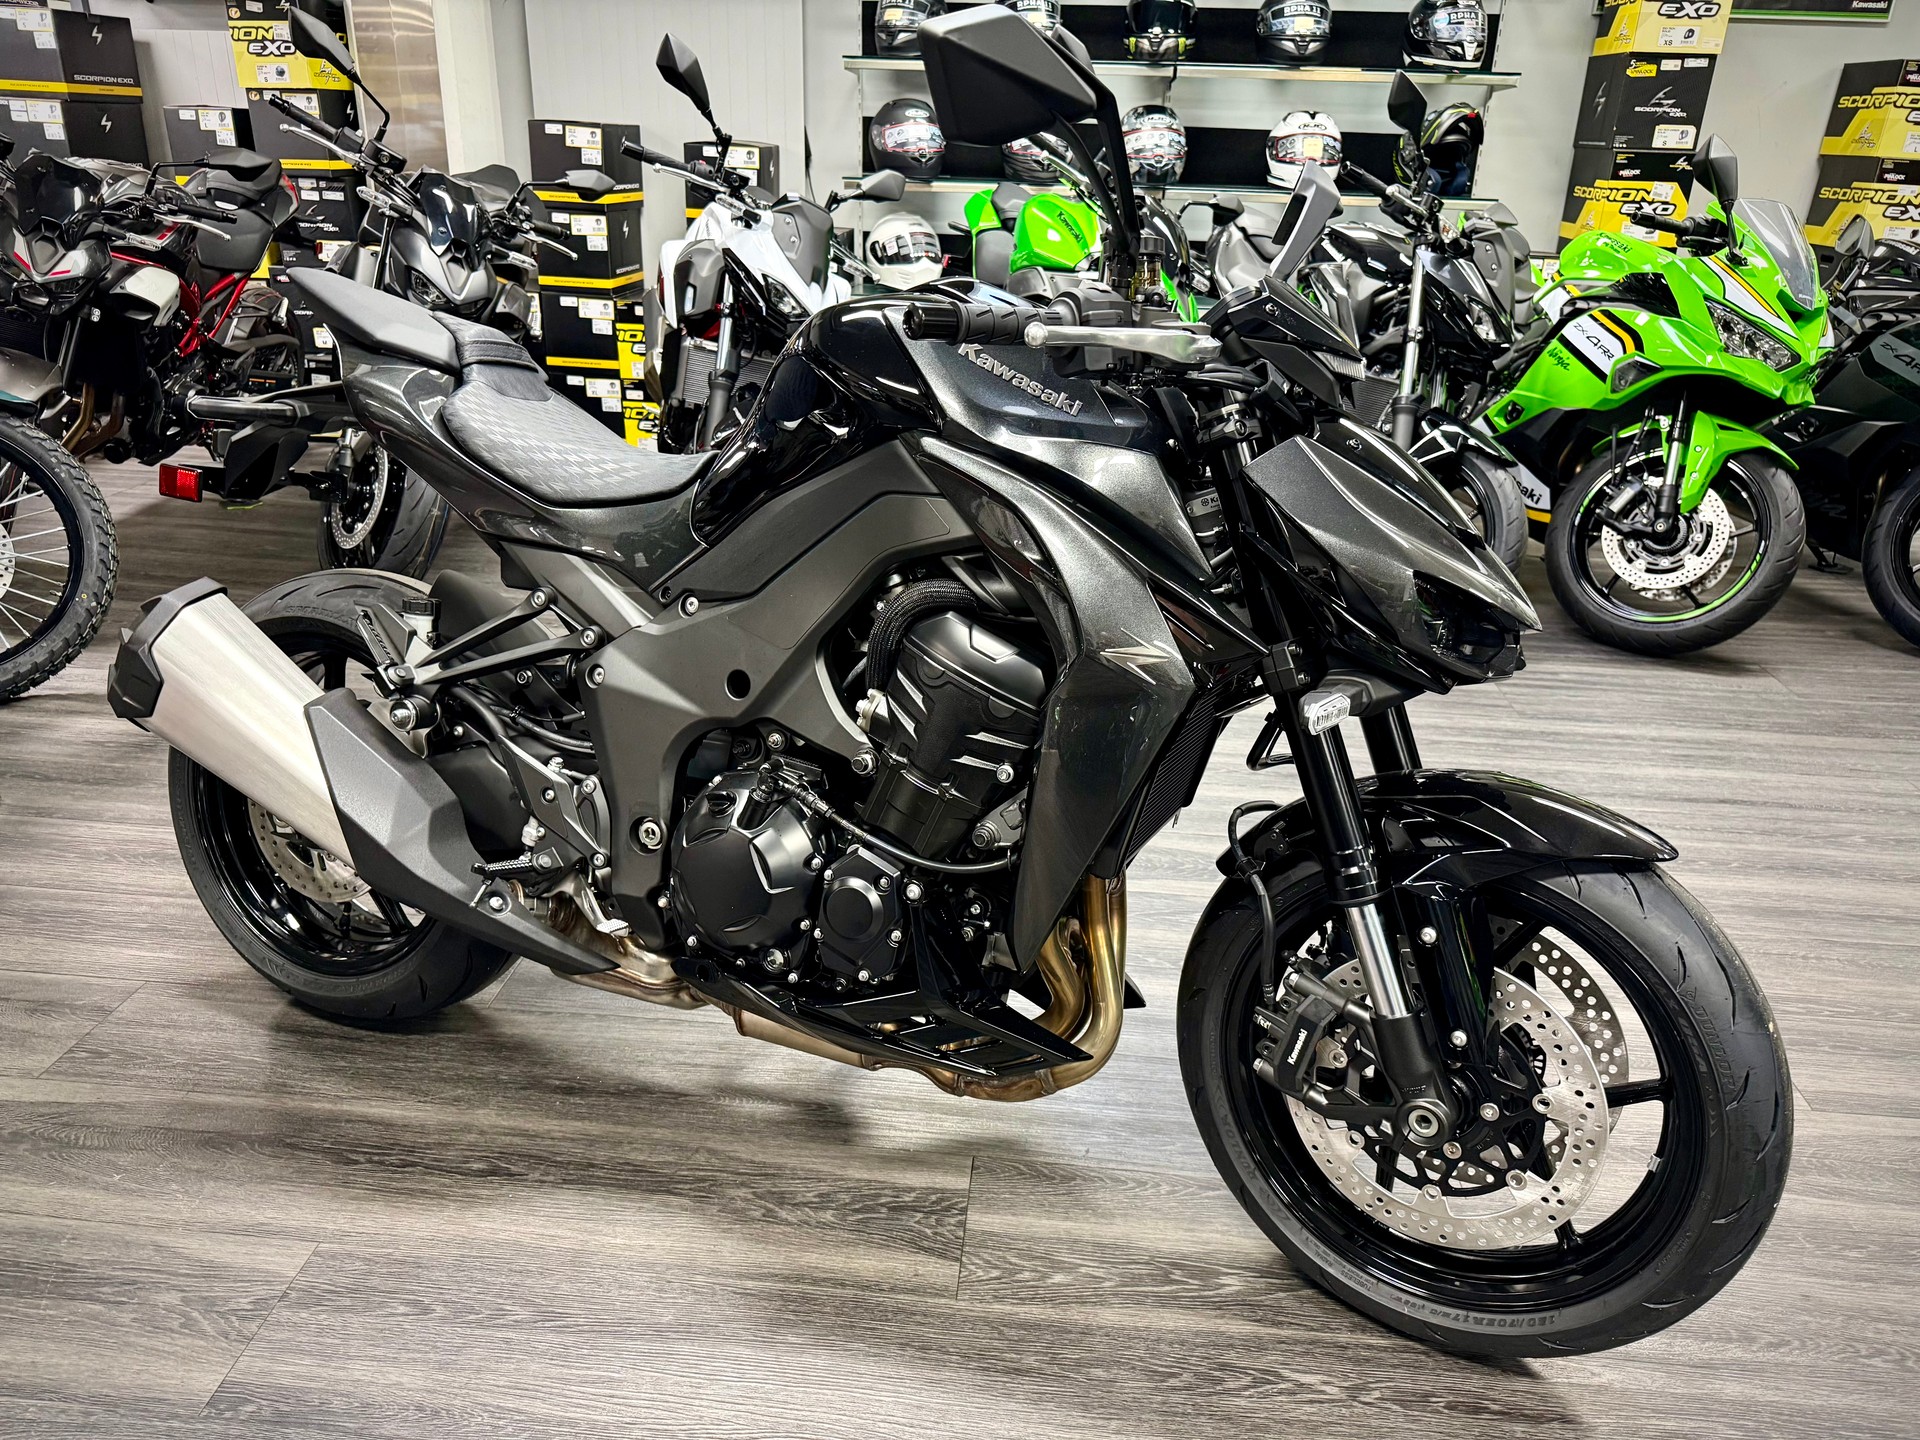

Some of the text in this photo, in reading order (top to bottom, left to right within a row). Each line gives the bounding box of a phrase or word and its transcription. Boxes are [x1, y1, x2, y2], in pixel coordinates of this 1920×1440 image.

[1283, 5, 1321, 14] RPHA 11
[1851, 1, 1888, 9] Kawasaki
[1450, 12, 1476, 21] RPHA
[73, 74, 117, 83] SCORPION
[1573, 185, 1655, 202] SCORPION
[1057, 211, 1083, 243] Kawasaki
[1546, 346, 1571, 371] Ninja
[958, 342, 1084, 417] Kawasaki
[1286, 1027, 1308, 1066] Kawasaki
[1313, 1248, 1373, 1292] TUBELESS RADIAL
